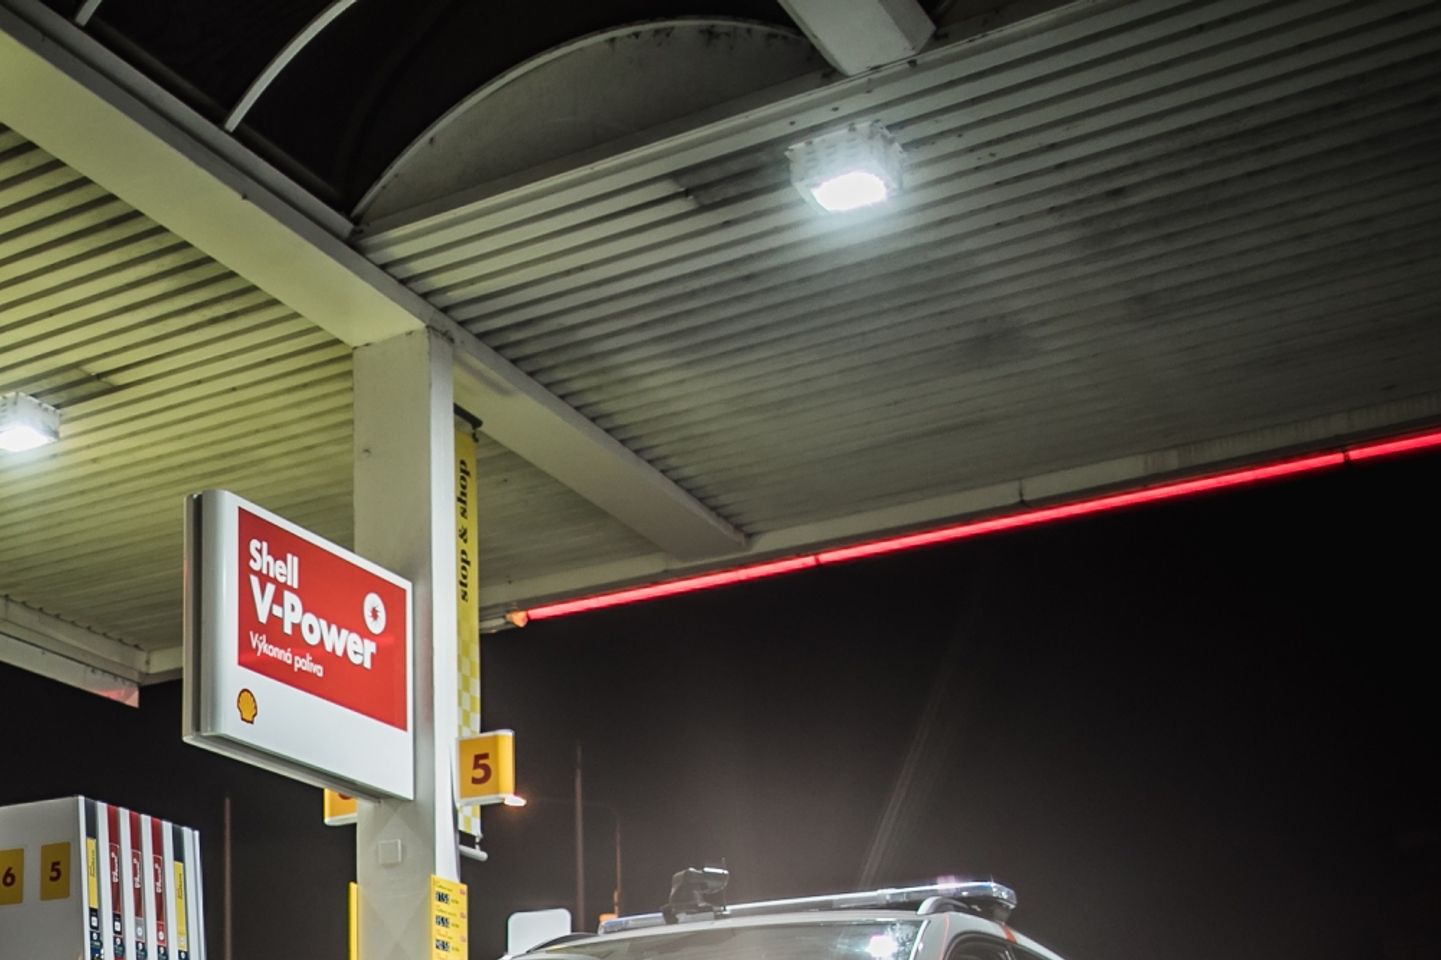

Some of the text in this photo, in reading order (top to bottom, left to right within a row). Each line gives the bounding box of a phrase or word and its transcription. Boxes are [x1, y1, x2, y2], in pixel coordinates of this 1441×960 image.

[456, 459, 471, 602] stop & shop
[249, 538, 299, 589] Shell
[249, 573, 377, 669] V-Power
[249, 630, 324, 677] Výkonná paliva
[471, 753, 492, 785] 5
[2, 867, 16, 888] 6
[49, 861, 62, 882] 5
